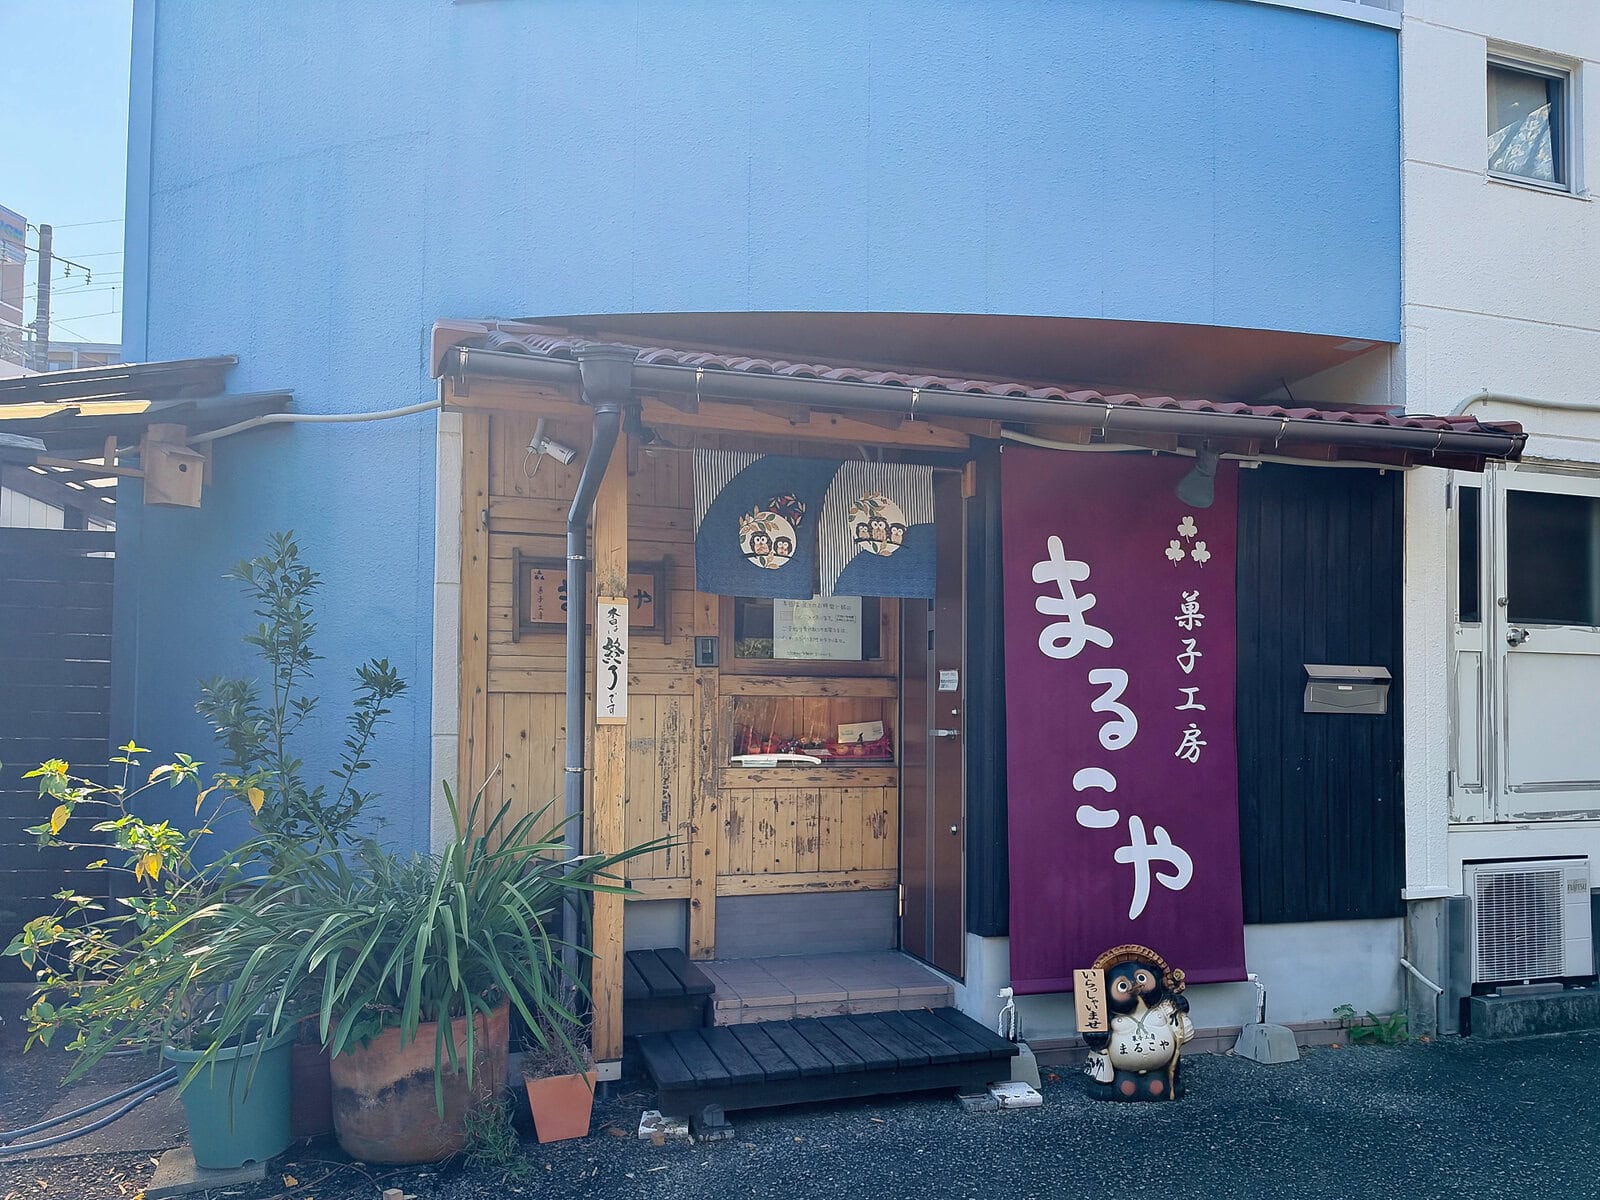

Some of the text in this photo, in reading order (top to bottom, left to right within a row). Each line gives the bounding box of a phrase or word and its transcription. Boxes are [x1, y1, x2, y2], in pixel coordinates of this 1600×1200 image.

[1031, 535, 1193, 920] まるこや
[1174, 590, 1207, 763] 菓子工房
[1081, 970, 1102, 1030] いらっしゃいませ
[1119, 1039, 1170, 1055] まるこや
